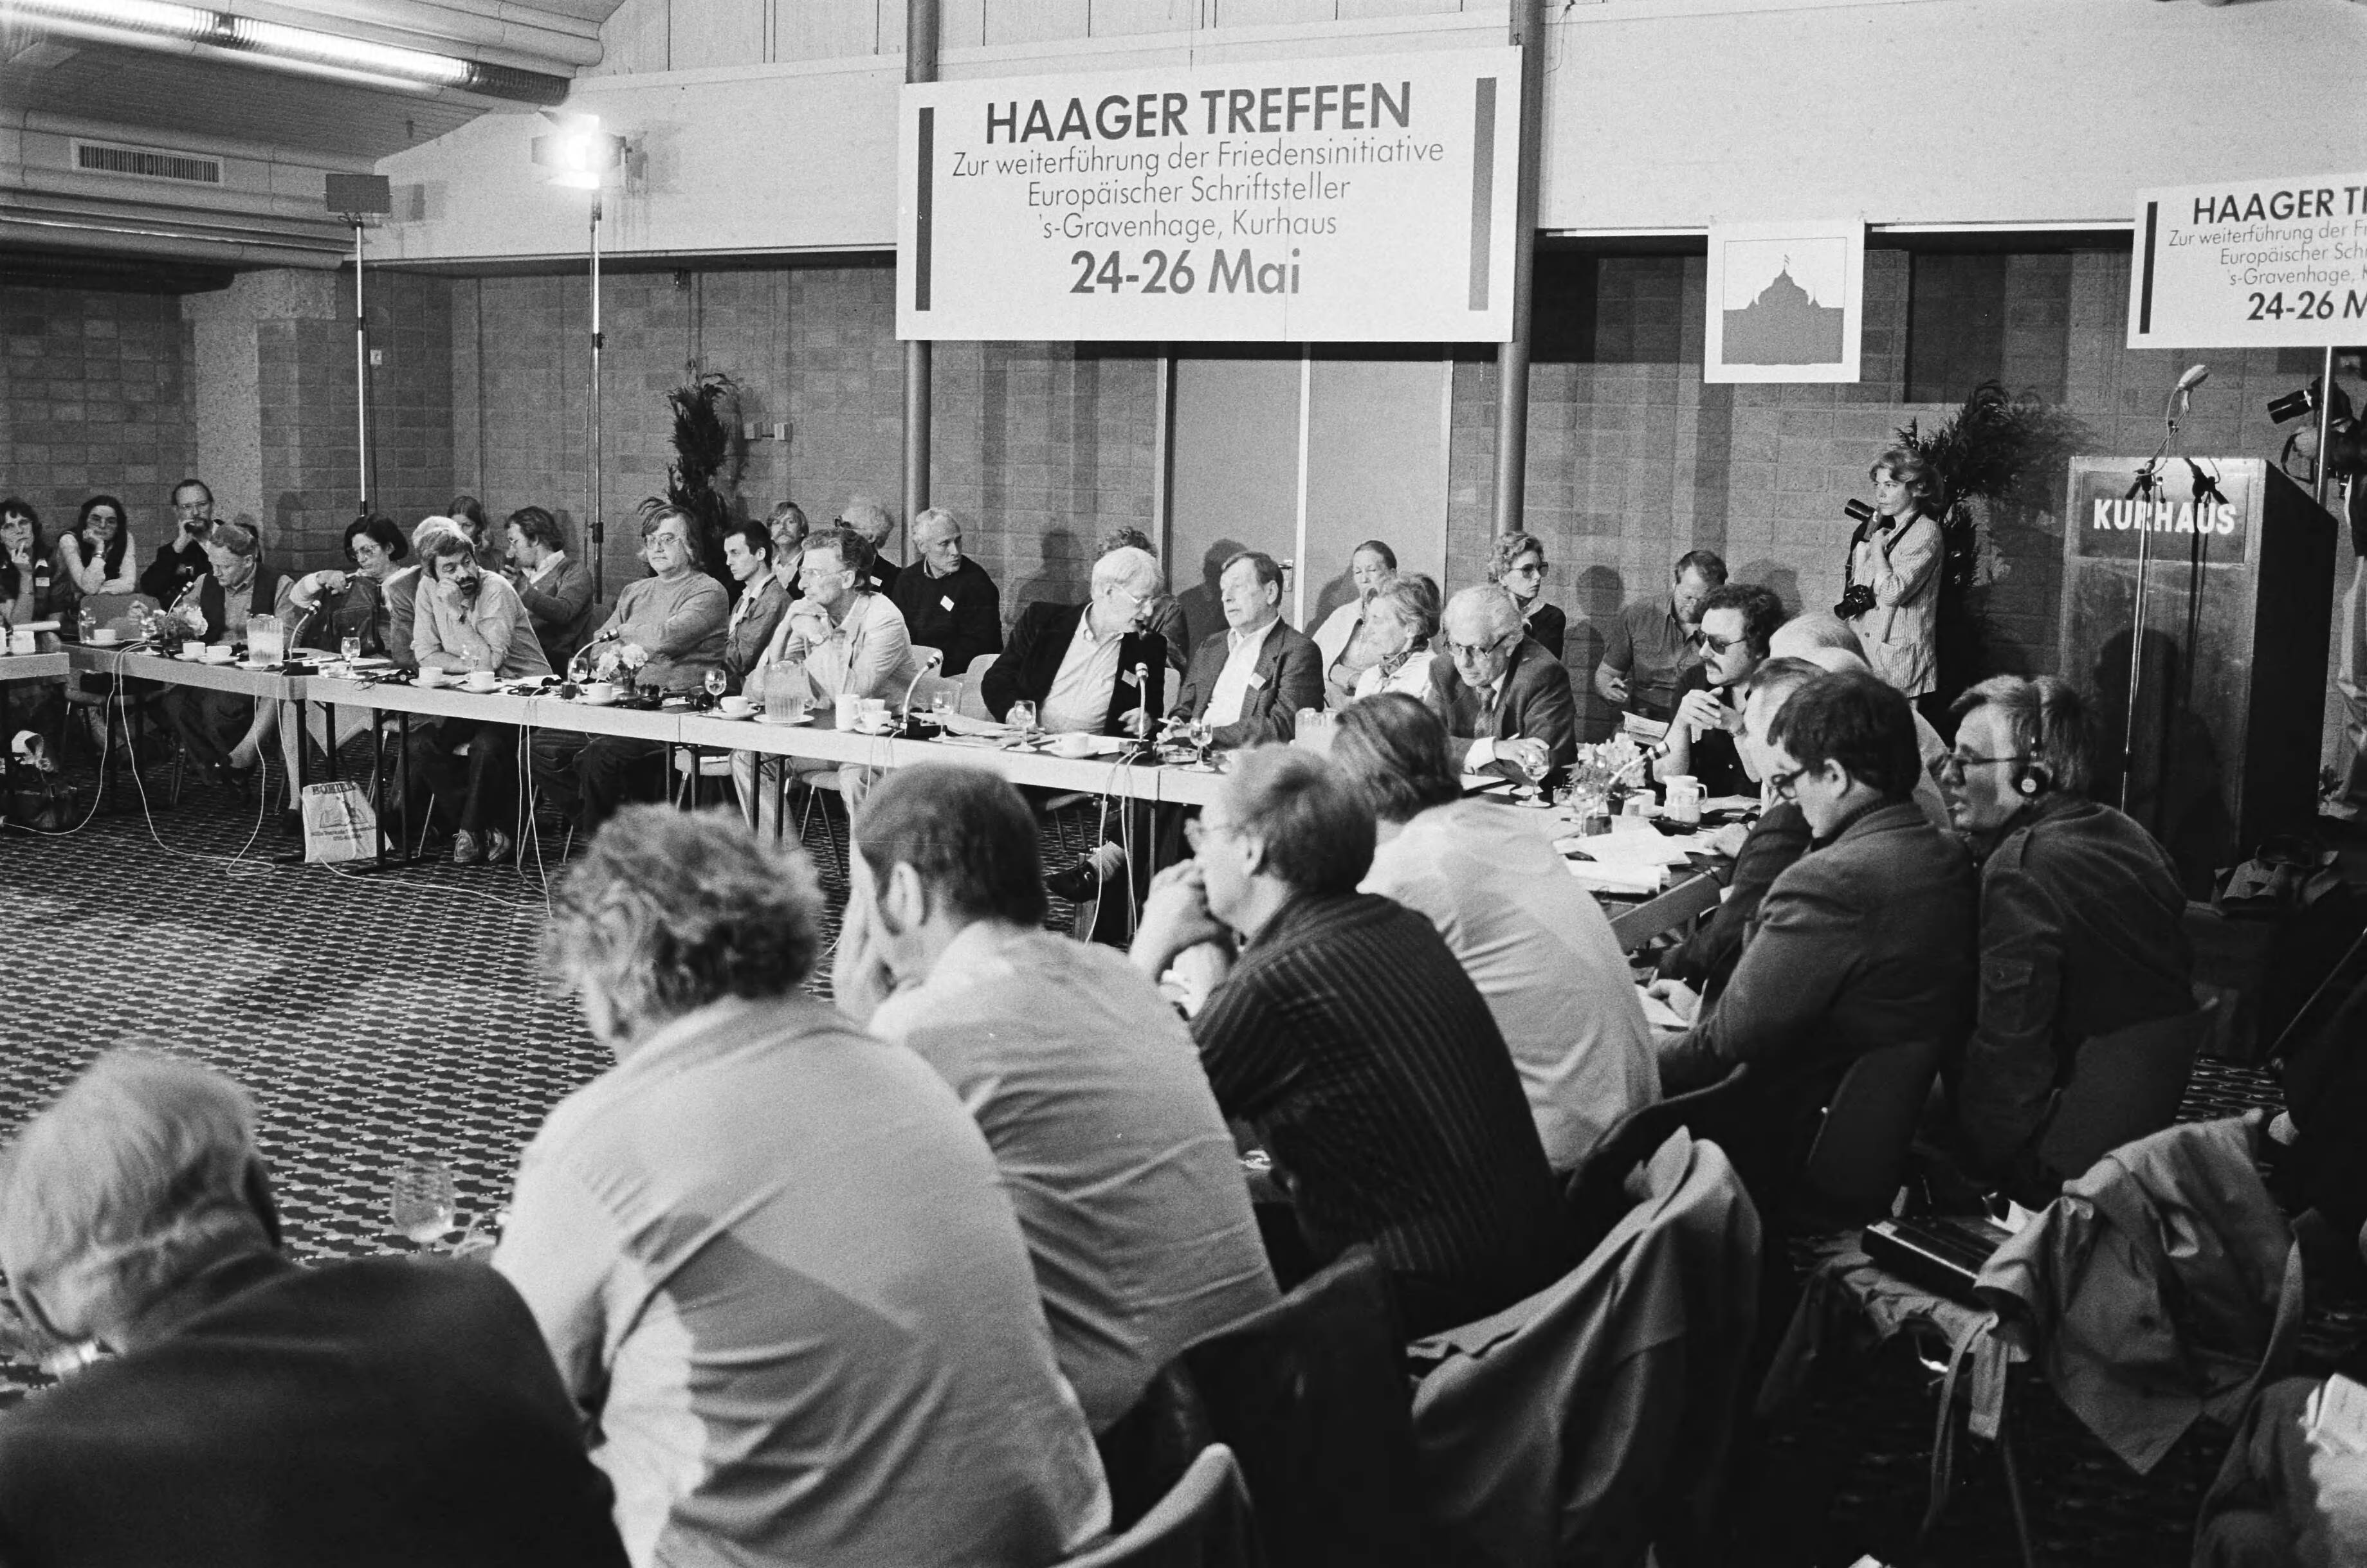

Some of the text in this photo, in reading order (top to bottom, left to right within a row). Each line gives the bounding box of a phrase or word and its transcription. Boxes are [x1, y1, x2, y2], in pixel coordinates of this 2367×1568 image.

[987, 81, 1411, 144] HAAGER TREFFEN
[952, 135, 1443, 177] Zur weiterführung der Friedensinitiative
[1029, 174, 1351, 208] Europäischer Schriftsteller
[2193, 186, 2367, 224] HAAGER T
[1039, 208, 1337, 242] 's-Gravenhage, Kurhaus
[2168, 229, 2195, 247] Zur
[2199, 224, 2313, 247] weiterführung
[2319, 221, 2348, 239] der
[2220, 240, 2367, 267] Europäischer Sch
[1070, 248, 1301, 294] 24-26 Mai
[2228, 264, 2354, 286] 's-Gravenhage,
[2247, 290, 2335, 320] 24-26
[2093, 498, 2236, 535] KURHAUS
